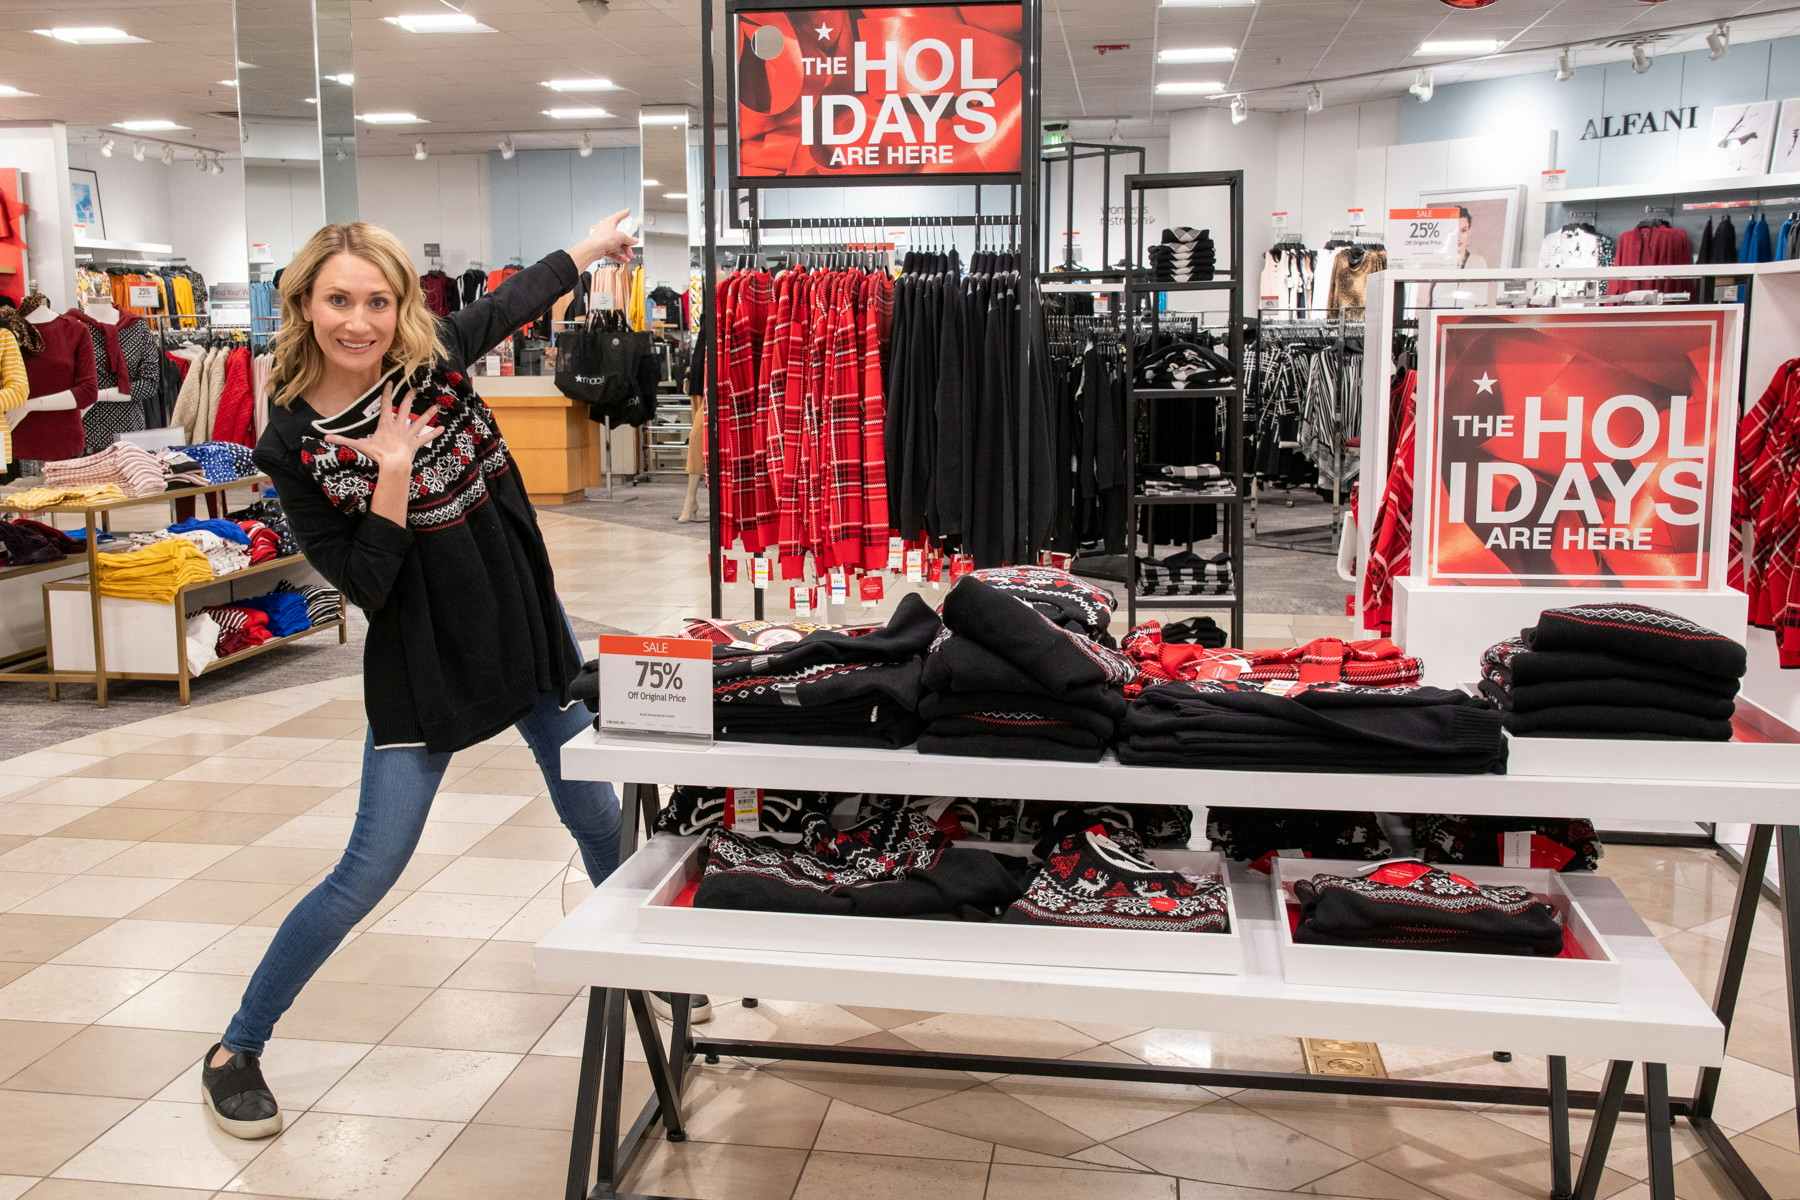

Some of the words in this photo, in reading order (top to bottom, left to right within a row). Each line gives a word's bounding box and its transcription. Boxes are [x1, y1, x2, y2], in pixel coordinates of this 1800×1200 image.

[801, 57, 847, 75] THE
[854, 38, 998, 92] HOL
[801, 91, 998, 146] IDAYS
[1579, 106, 1700, 141] ALFANI
[830, 146, 880, 166] ARE
[887, 145, 954, 165] HERE
[1416, 209, 1433, 217] SALE
[1409, 222, 1440, 238] 25%
[1452, 415, 1514, 437] THE
[1522, 395, 1706, 460] HOL
[1448, 460, 1705, 526] IDAYS
[1485, 527, 1552, 550] ARE
[1563, 527, 1653, 550] HERE
[642, 641, 669, 654] SALE
[635, 660, 683, 690] 75%
[627, 691, 639, 700] Off
[640, 691, 667, 703] Original
[668, 693, 687, 703] Price
